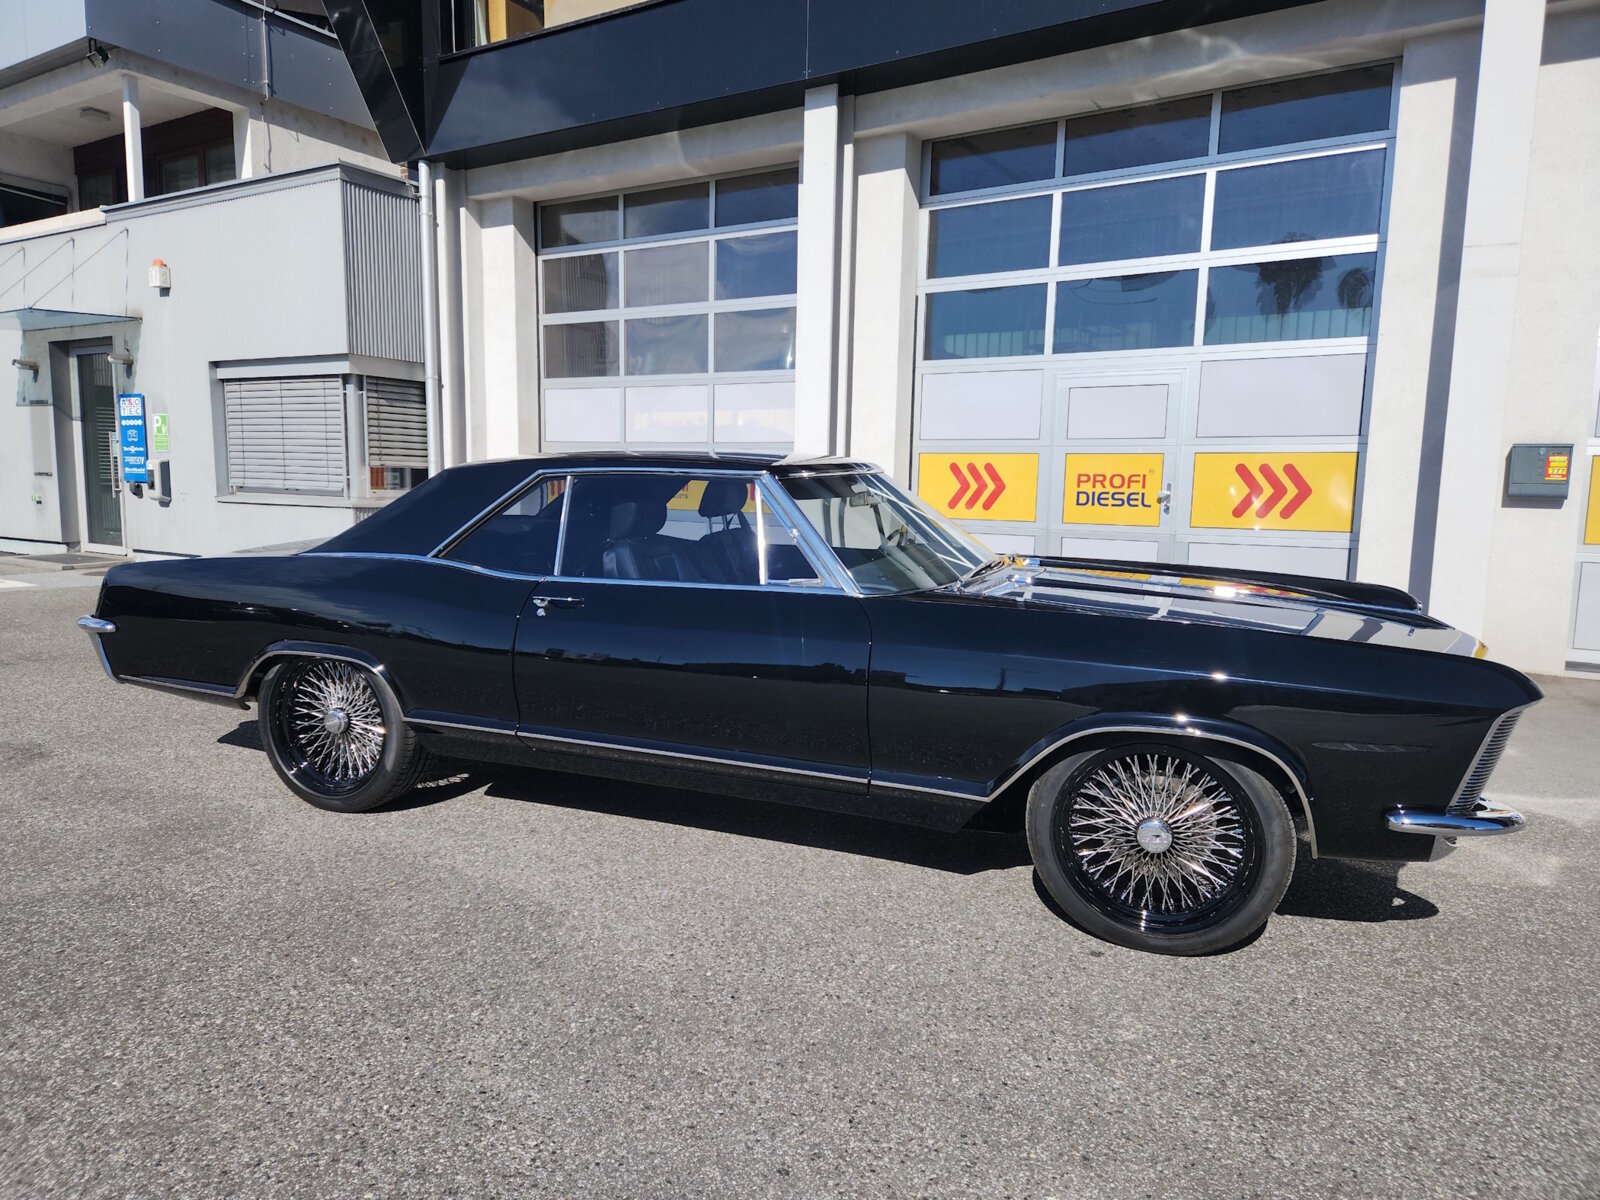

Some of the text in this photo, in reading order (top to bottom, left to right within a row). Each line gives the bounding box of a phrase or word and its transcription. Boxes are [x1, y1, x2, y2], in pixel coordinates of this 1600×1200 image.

[122, 407, 141, 415] TEC
[153, 415, 162, 433] P
[1076, 473, 1146, 489] PROFI
[1076, 490, 1151, 508] DIESEL
